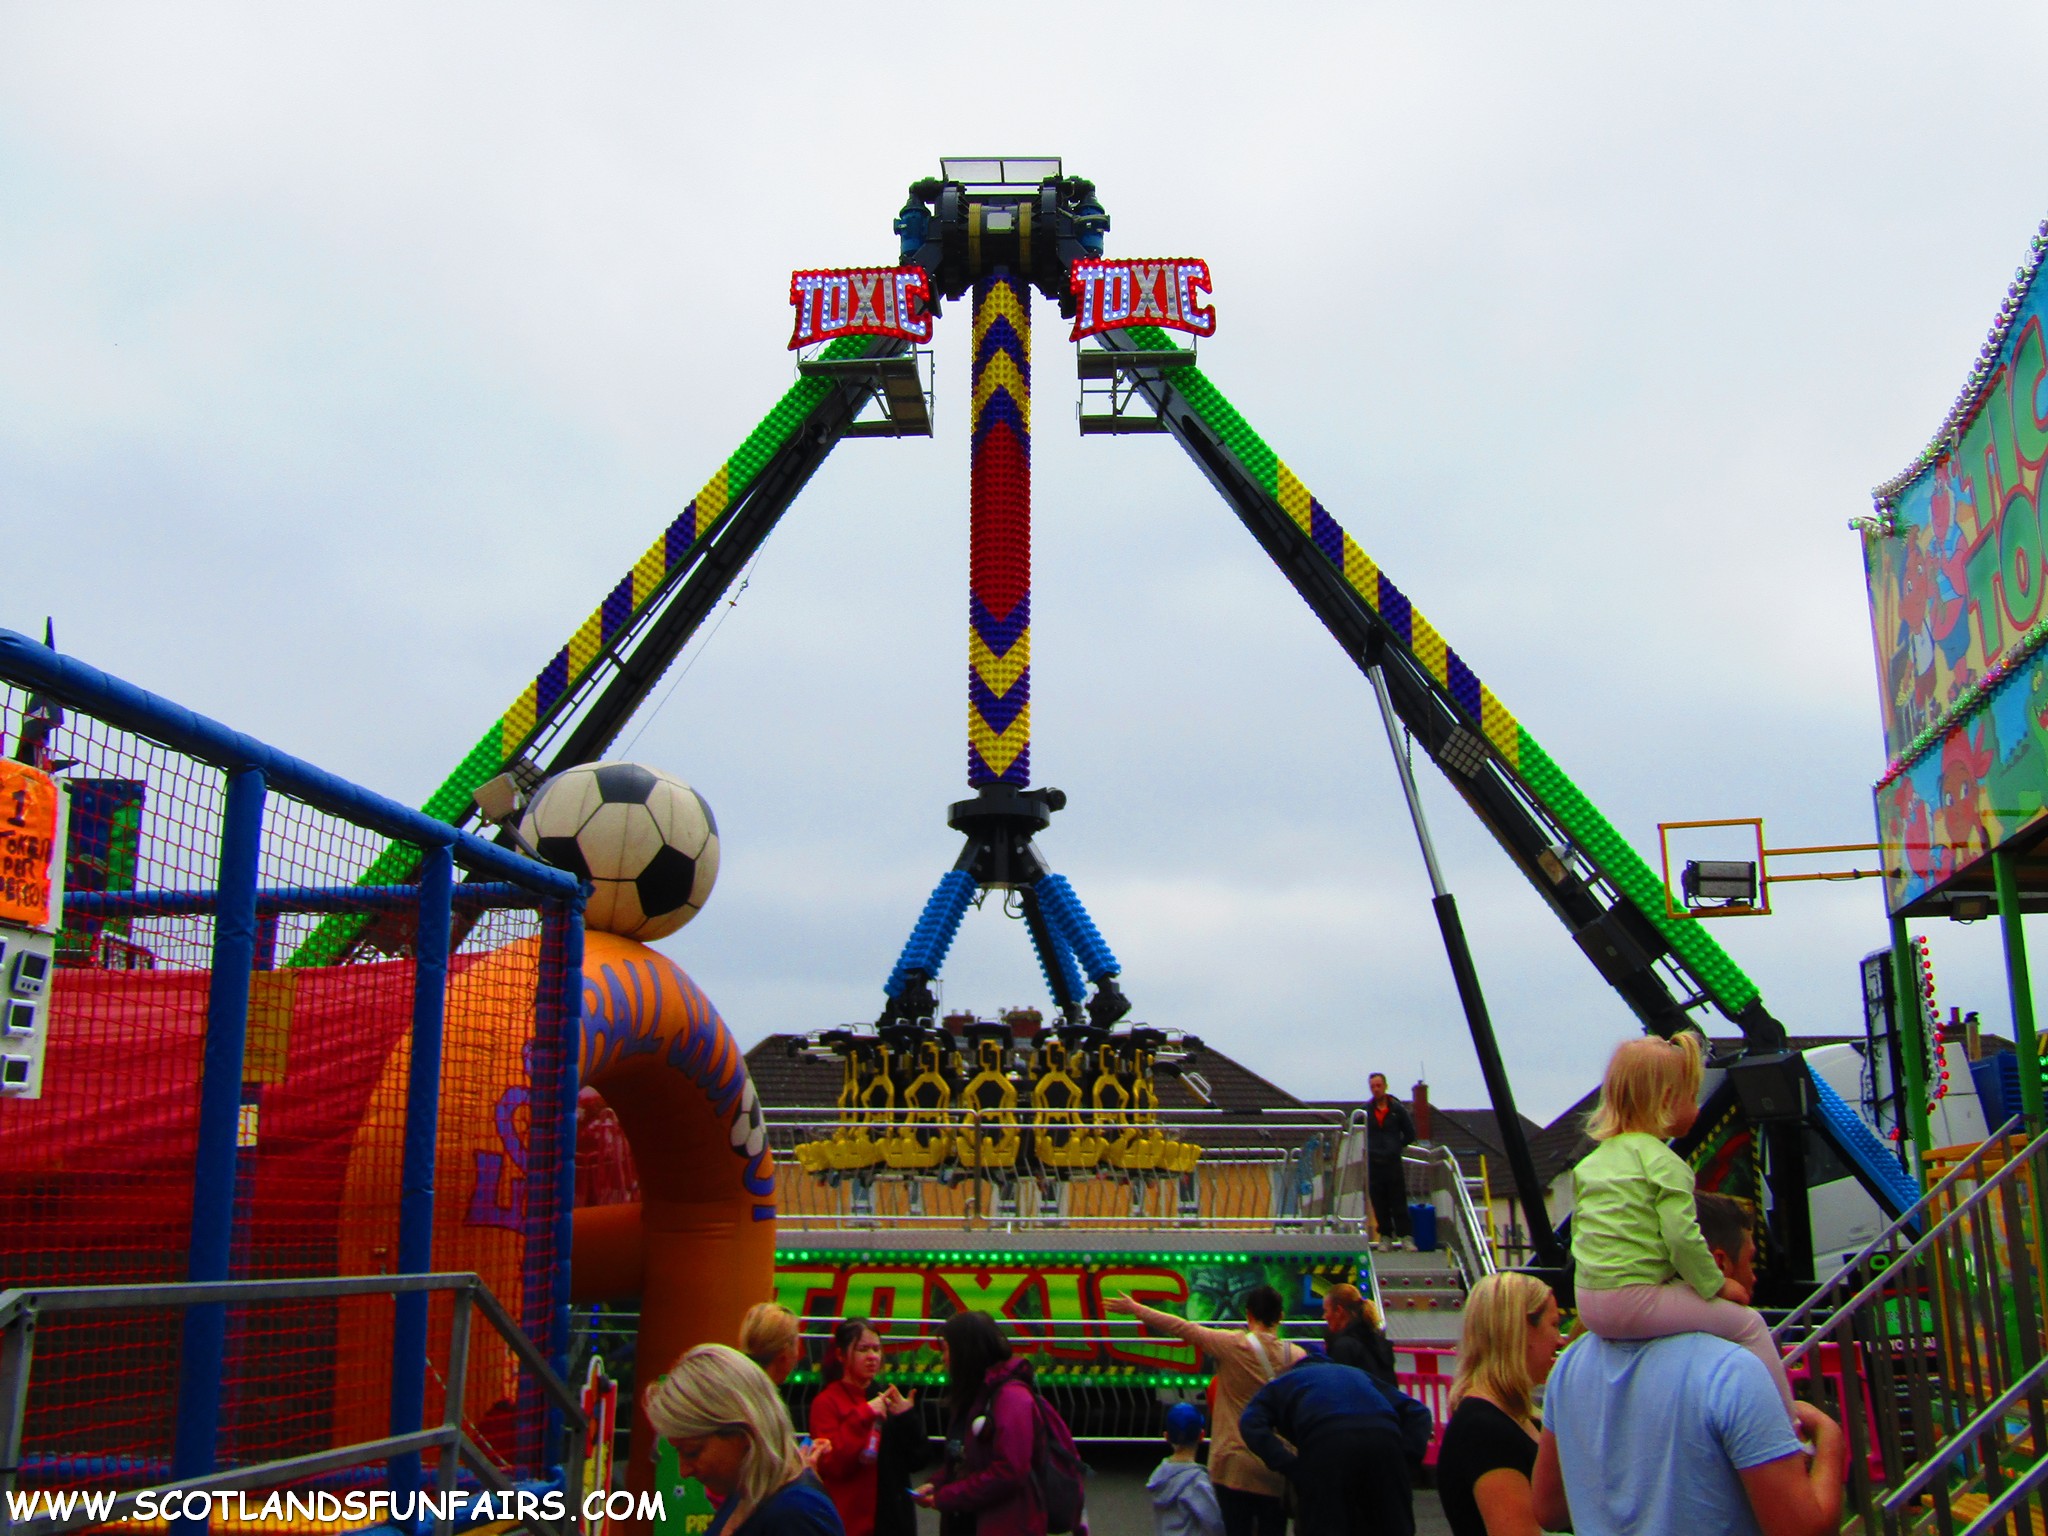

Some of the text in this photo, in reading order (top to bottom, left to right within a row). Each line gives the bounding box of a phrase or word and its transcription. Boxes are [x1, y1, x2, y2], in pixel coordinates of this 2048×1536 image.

[795, 271, 928, 337] TOXIC
[1077, 263, 1212, 329] TOXIC
[1962, 455, 2048, 668] TO
[7, 789, 26, 828] 1
[4, 856, 35, 879] PER
[774, 1263, 1203, 1373] TOXIC
